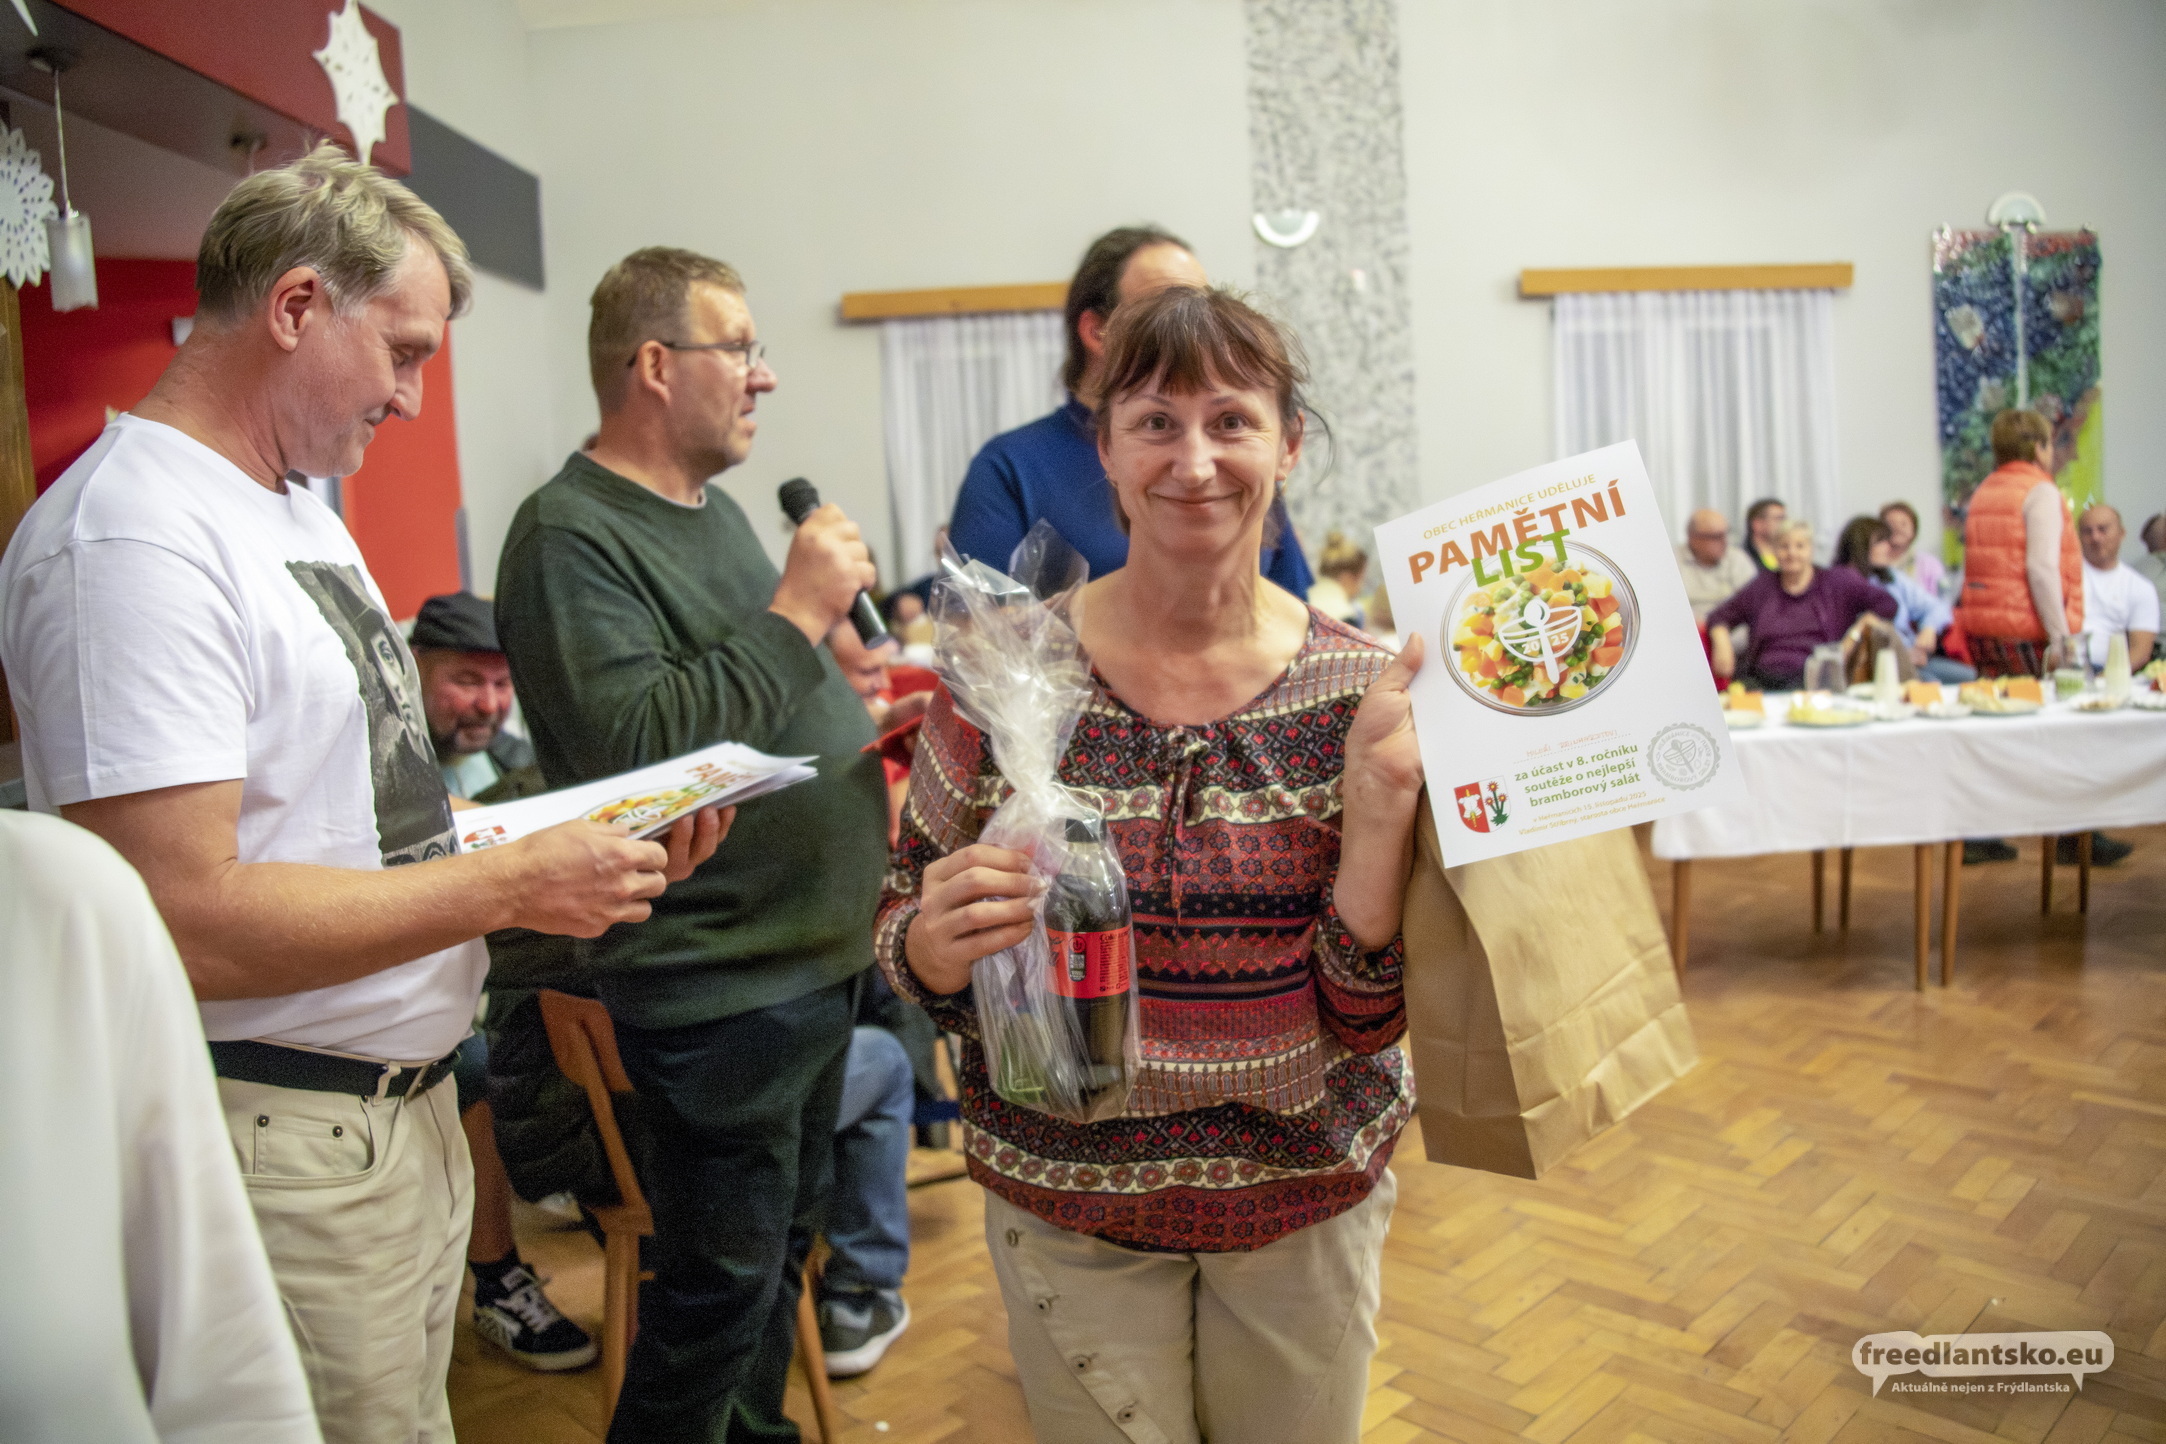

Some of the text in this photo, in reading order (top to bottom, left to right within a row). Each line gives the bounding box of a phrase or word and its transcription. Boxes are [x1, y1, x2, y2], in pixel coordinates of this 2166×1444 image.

[1423, 474, 1596, 540] OBEC HEŘMANICE UDĚLUJE
[1408, 478, 1626, 585] PAMĚTNÍ
[1471, 528, 1571, 588] LIST
[1515, 744, 1638, 781] za účast v 8. ročníku
[1524, 757, 1636, 794] soutěže o nejlepší
[1529, 772, 1641, 807] bramborový salát
